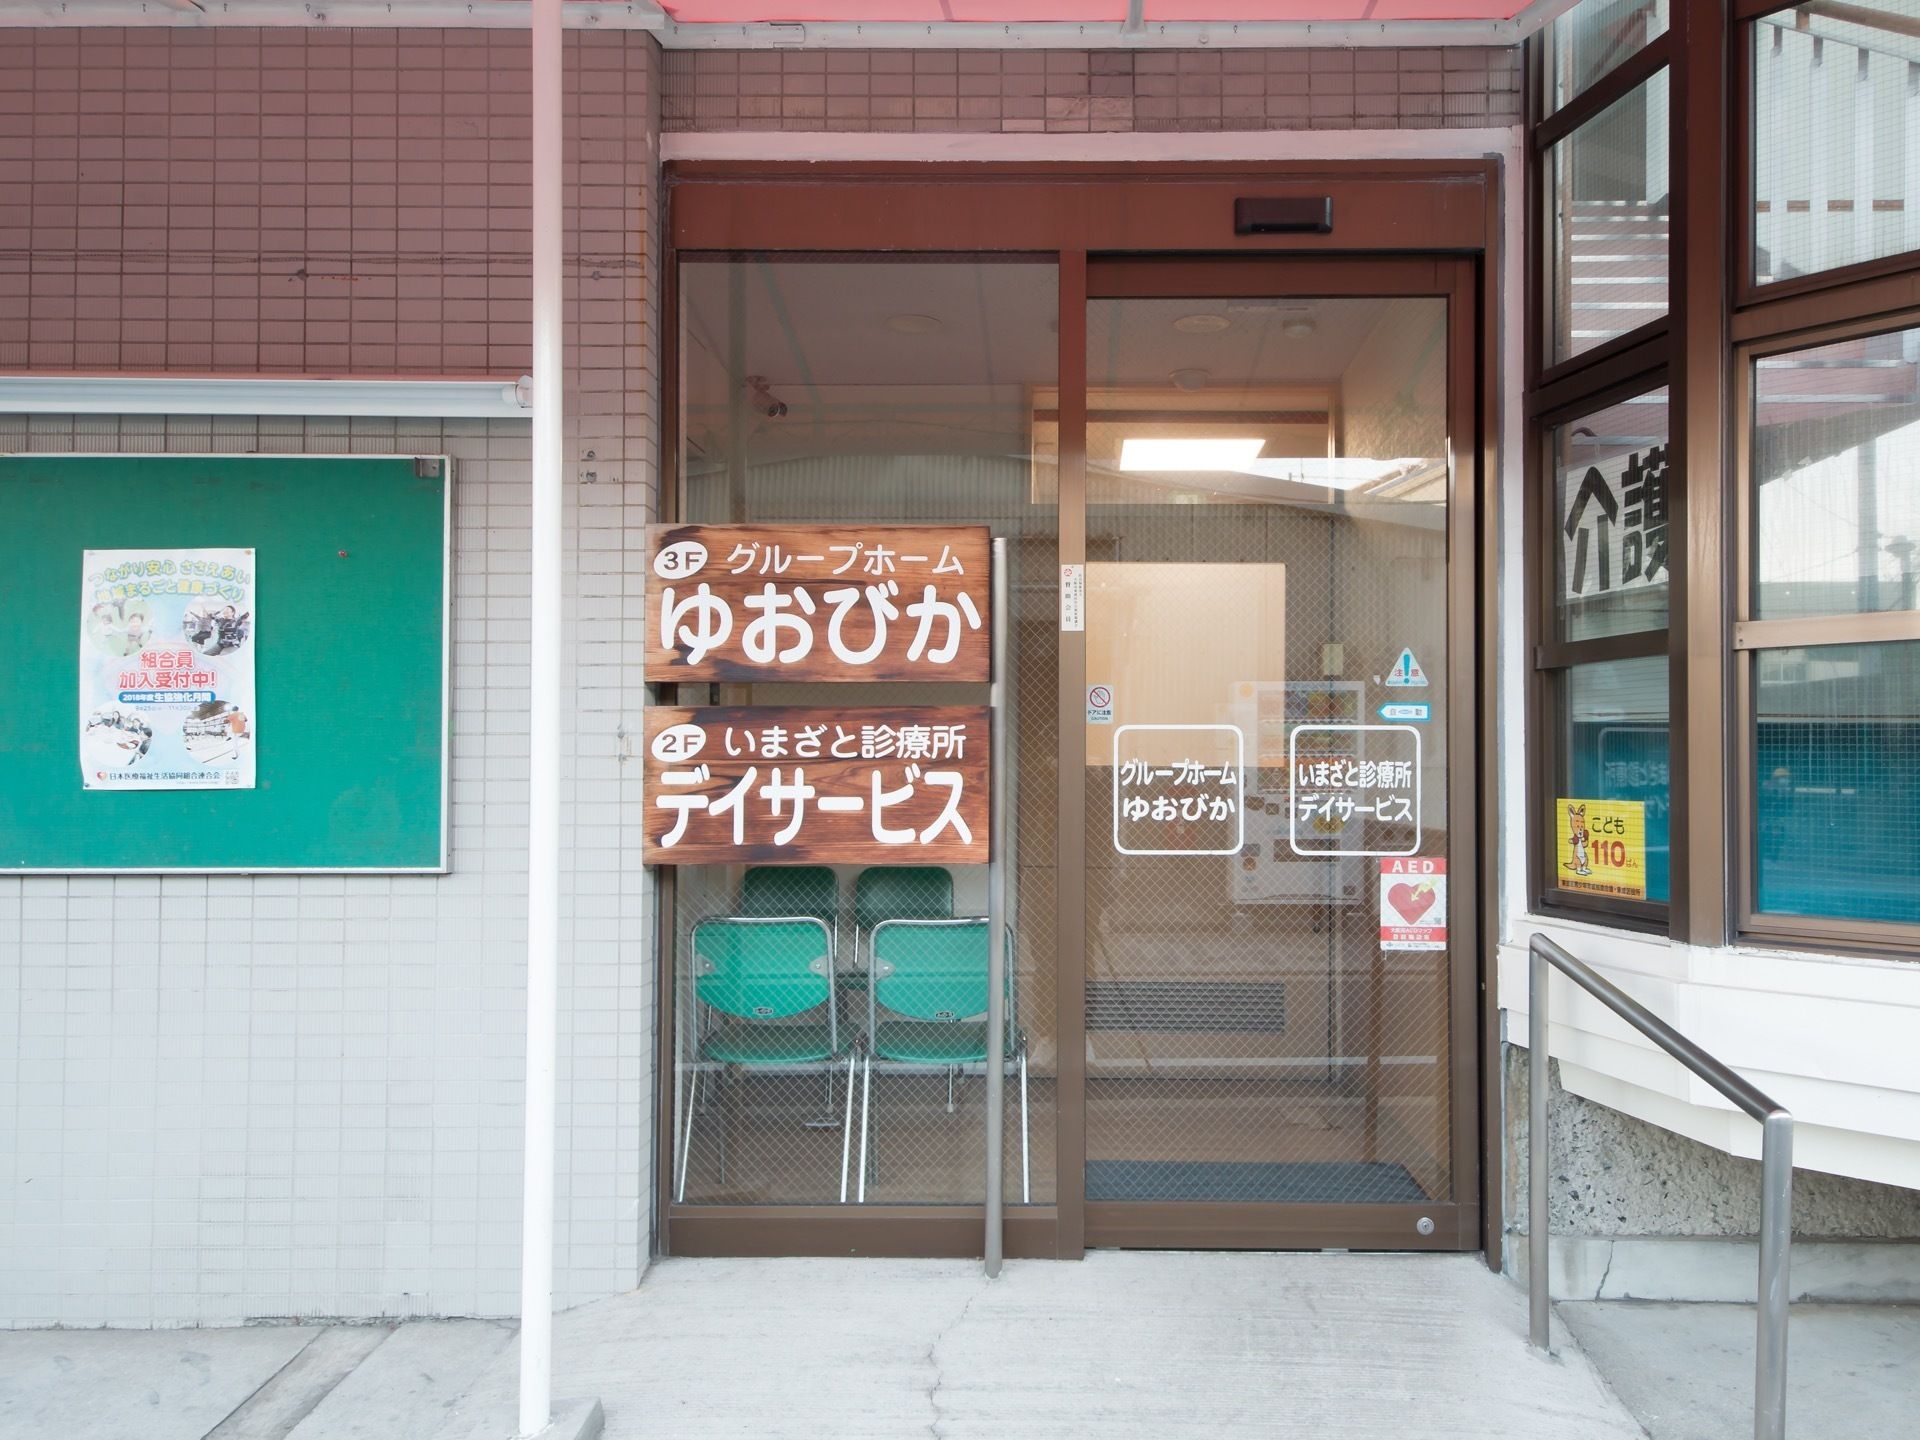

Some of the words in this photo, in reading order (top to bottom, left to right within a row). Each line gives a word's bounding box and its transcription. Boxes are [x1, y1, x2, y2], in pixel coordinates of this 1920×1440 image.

[663, 551, 703, 571] 3F
[727, 542, 965, 575] グループホーム
[661, 580, 982, 665] ゆおびか
[141, 652, 193, 669] 組合員
[119, 671, 216, 688] 加入受付中!
[662, 734, 701, 754] 2F
[725, 723, 966, 759] いまざと診療所
[1120, 758, 1237, 786] グループホーム
[1298, 760, 1412, 788] いまざと診療所
[656, 763, 973, 847] デイサービス
[1123, 793, 1235, 822] ゆおびか
[1298, 794, 1413, 823] デイサービス
[1592, 817, 1625, 834] こども
[1391, 860, 1434, 873] AED
